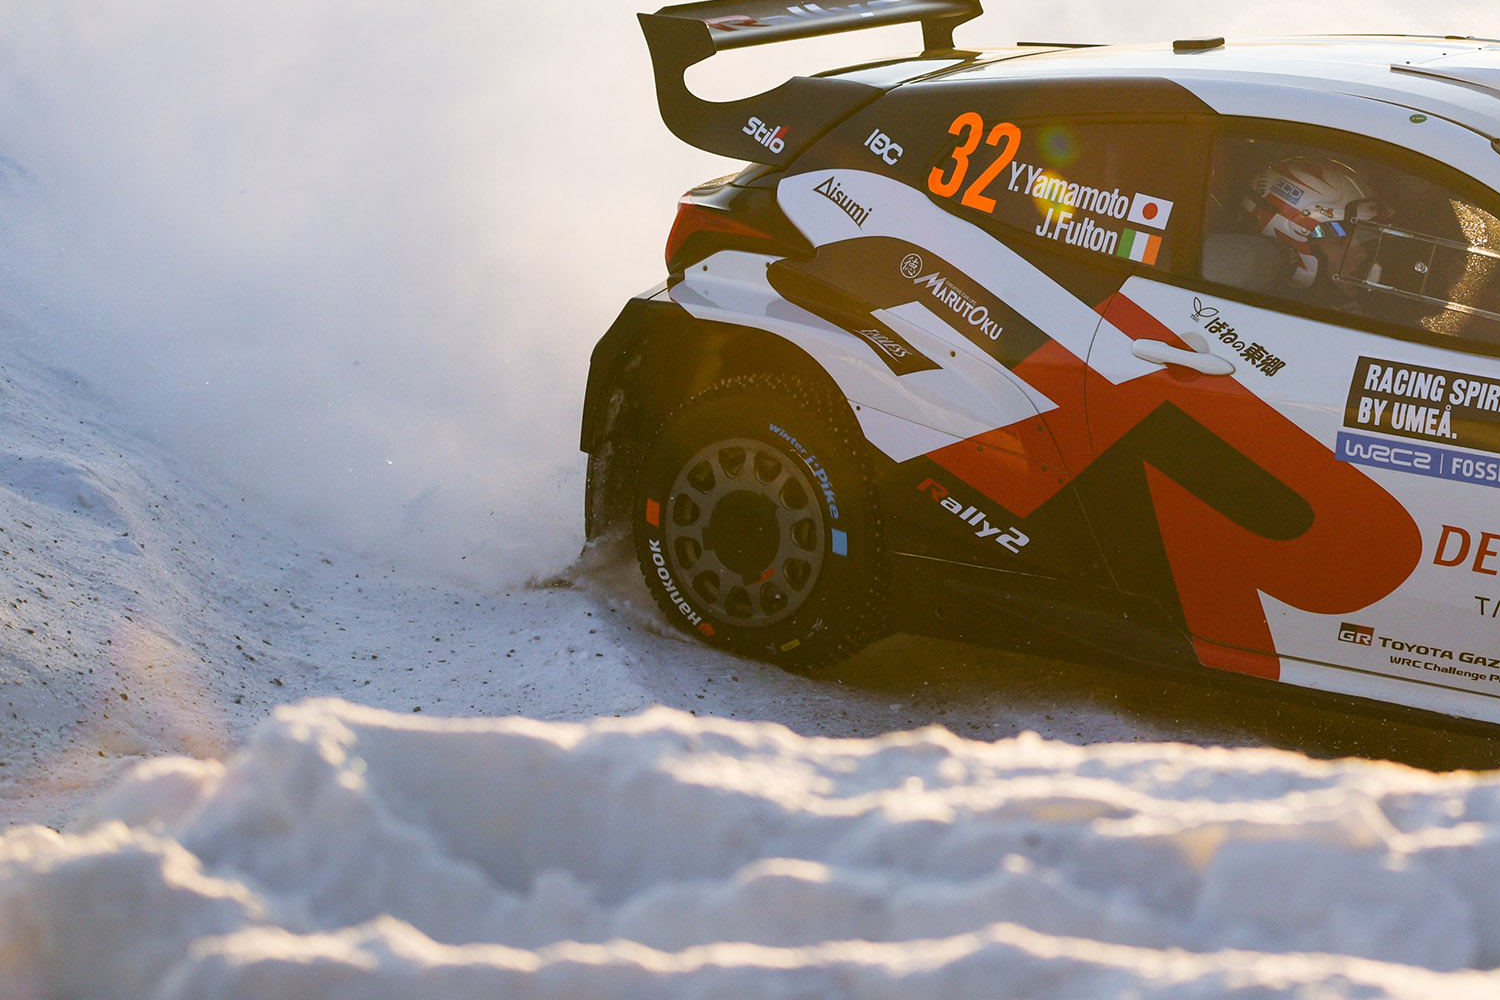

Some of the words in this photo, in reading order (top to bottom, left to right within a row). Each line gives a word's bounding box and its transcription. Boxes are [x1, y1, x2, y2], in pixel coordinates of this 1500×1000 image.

[742, 116, 786, 154] Stilo
[927, 111, 1022, 214] 32
[813, 176, 873, 230] Aisumi
[1036, 207, 1119, 255] J.Fulton
[1204, 317, 1287, 377] ばねの東郷
[1363, 363, 1446, 403] RACING
[1357, 396, 1388, 425] BY
[917, 476, 1030, 554] Rally2
[1338, 630, 1373, 646] GR
[1378, 636, 1453, 660] TOYOTA
[1389, 655, 1422, 669] WRC
[1423, 661, 1487, 682] Challenge
